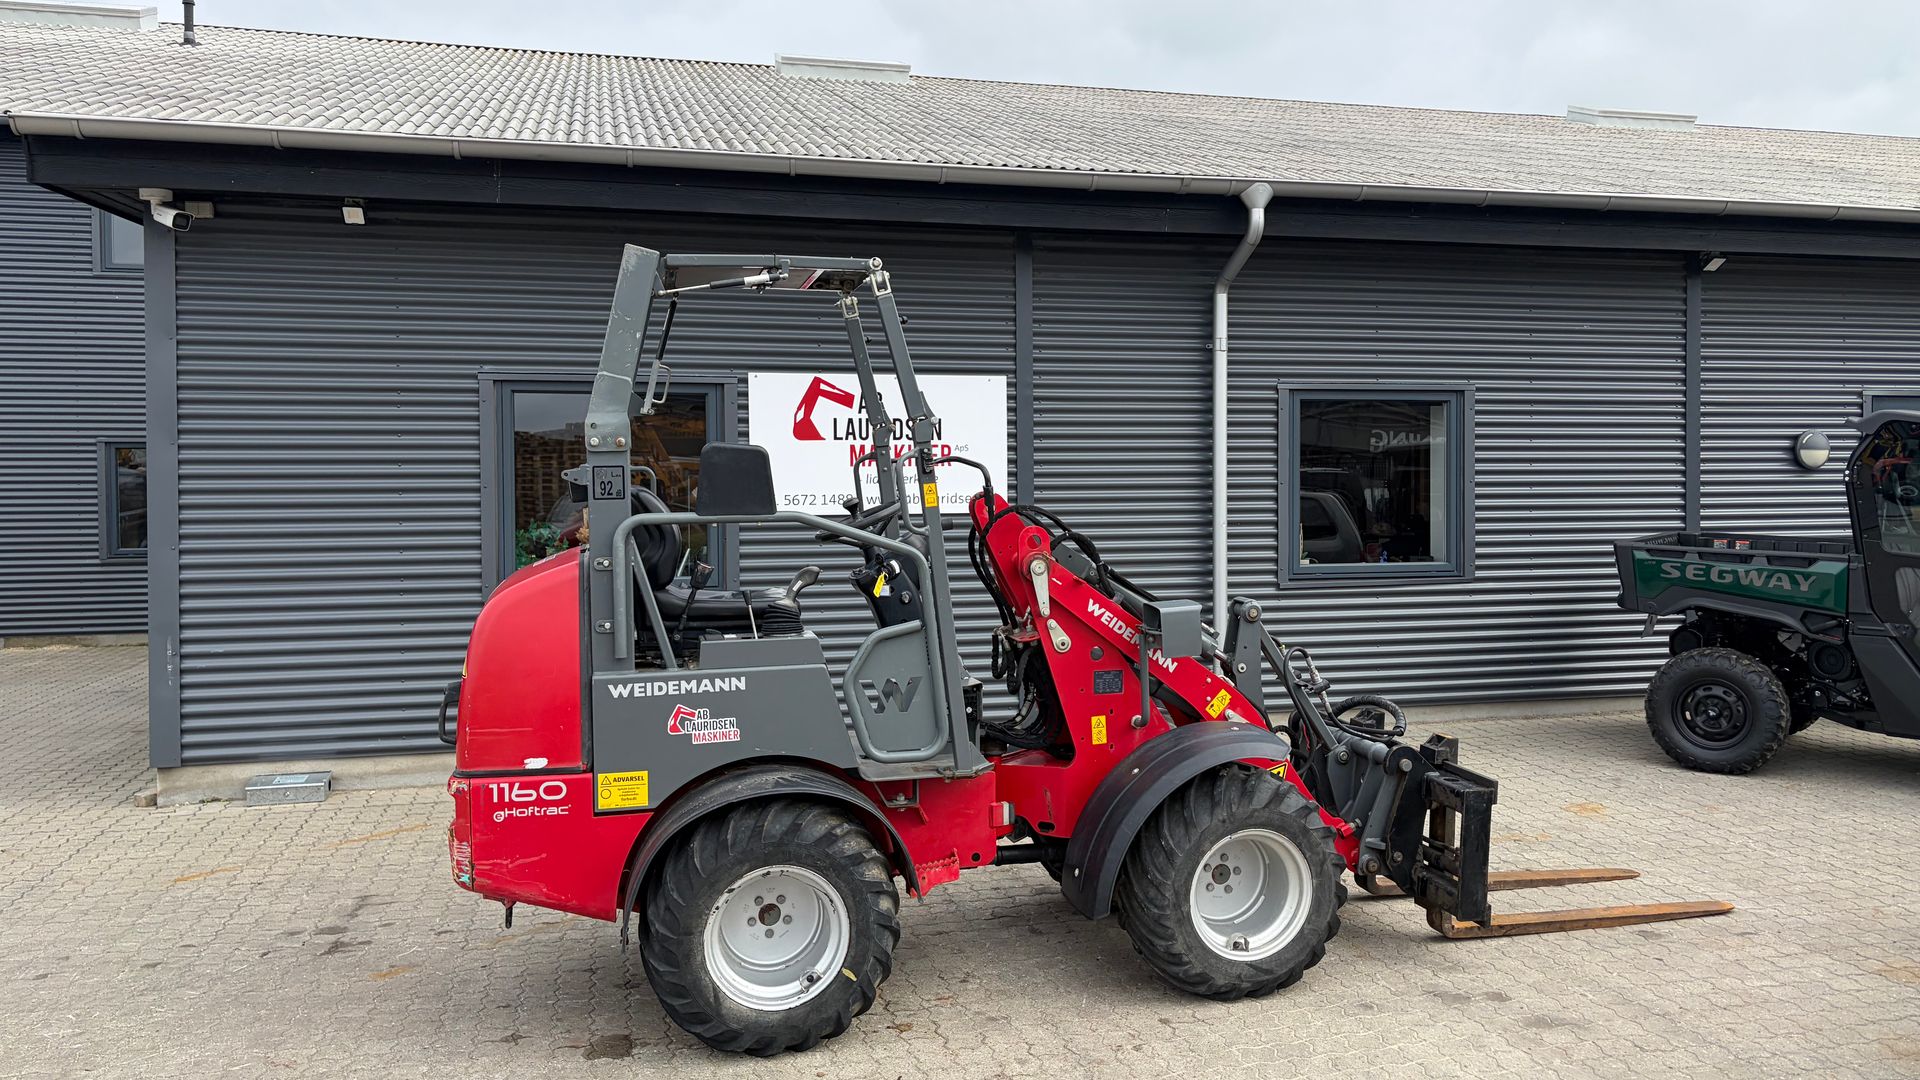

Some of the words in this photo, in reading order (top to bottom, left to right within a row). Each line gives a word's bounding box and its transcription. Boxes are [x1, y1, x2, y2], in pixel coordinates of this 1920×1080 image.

[954, 444, 969, 452] ApS
[600, 481, 613, 496] 92
[784, 494, 817, 506] 5672
[1660, 562, 1817, 592] SEGWAY
[607, 676, 746, 698] WEIDEMANN
[696, 709, 709, 720] AB
[686, 718, 735, 732] LAURIDSEN
[693, 729, 739, 743] MASKINER
[612, 775, 645, 783] ADVARSEL
[488, 780, 567, 803] 1160
